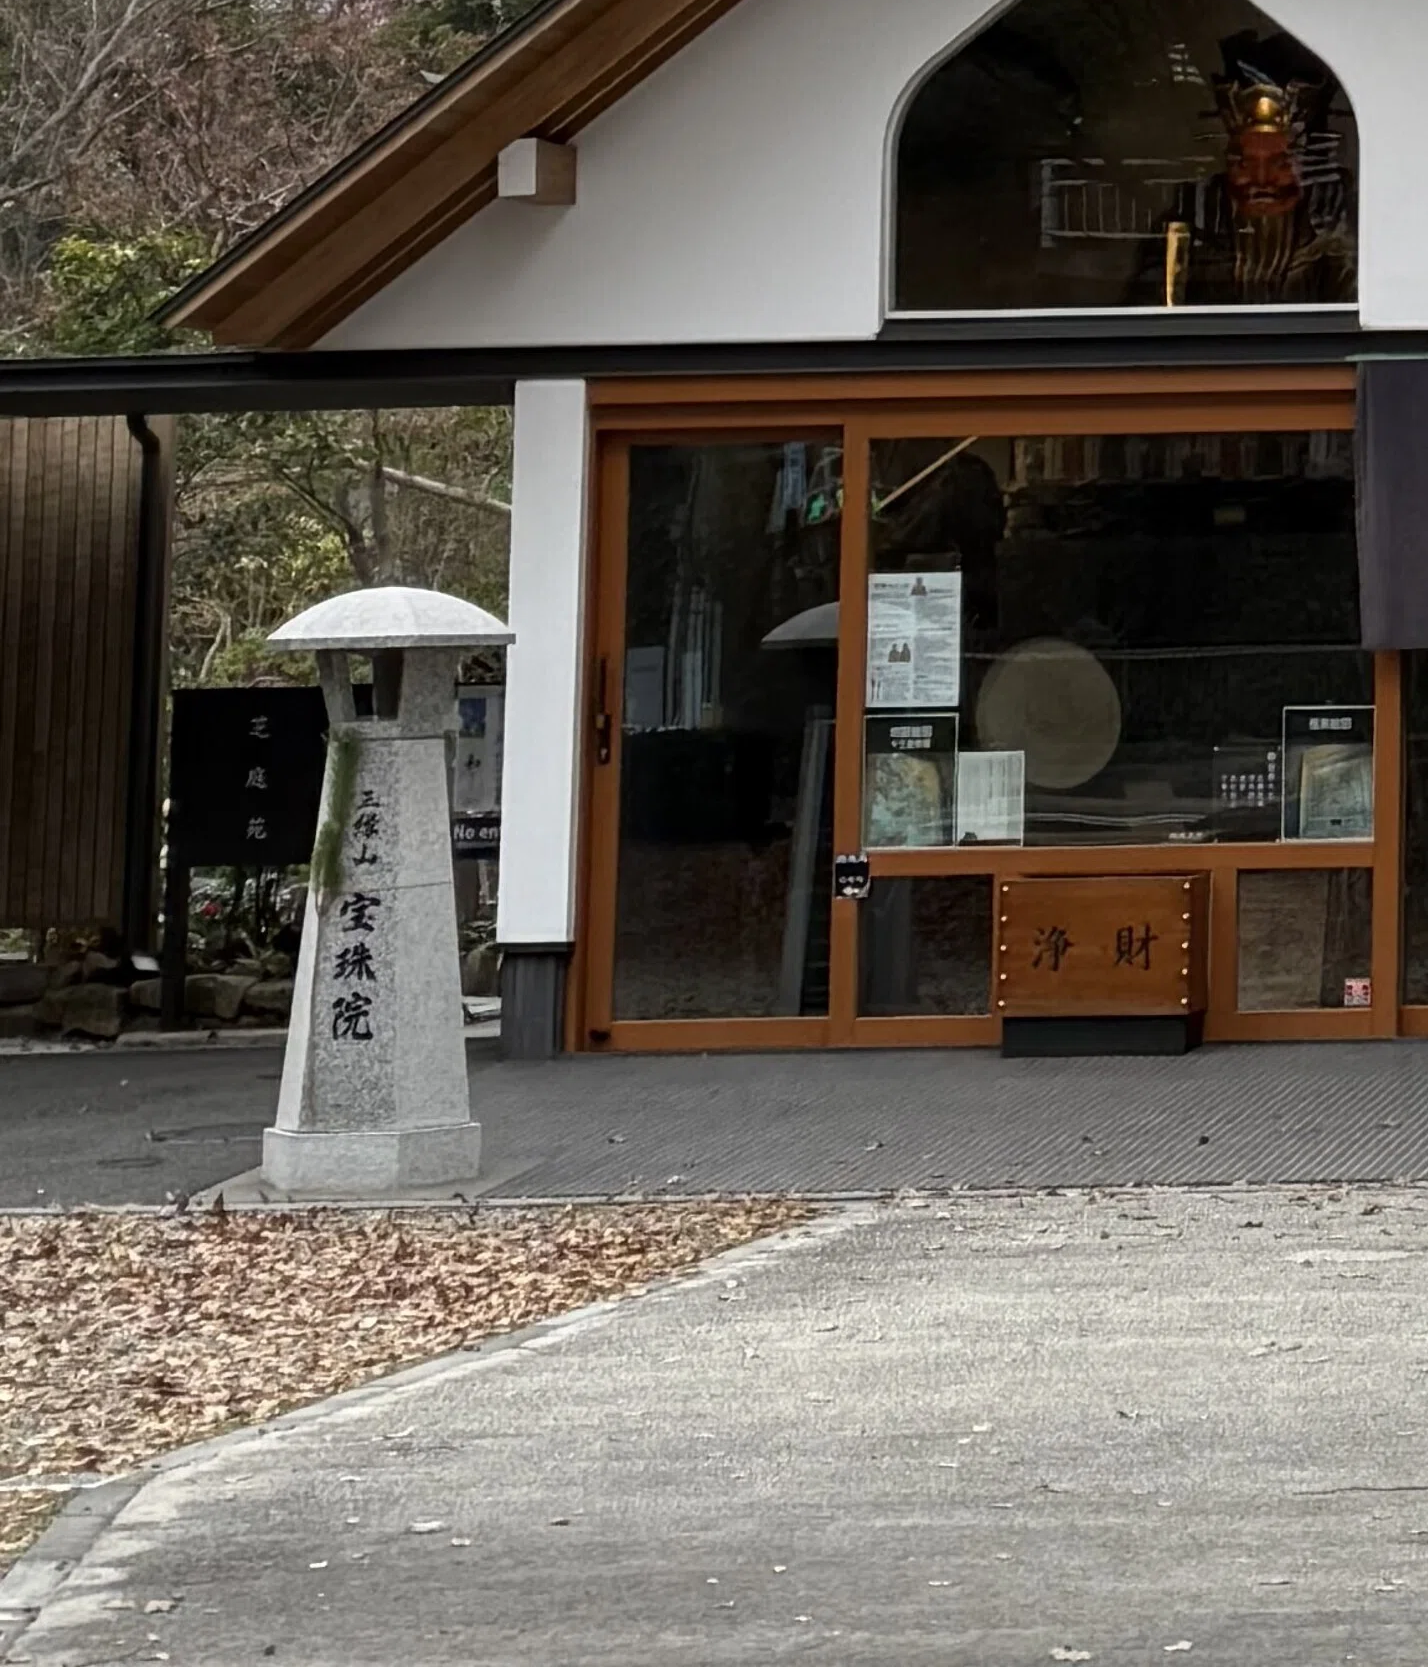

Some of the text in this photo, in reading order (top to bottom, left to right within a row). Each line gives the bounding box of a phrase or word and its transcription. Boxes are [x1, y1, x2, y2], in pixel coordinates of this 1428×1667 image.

[479, 825, 501, 840] en
[332, 892, 381, 1040] 宝珠院
[1032, 923, 1159, 971] 浄財
